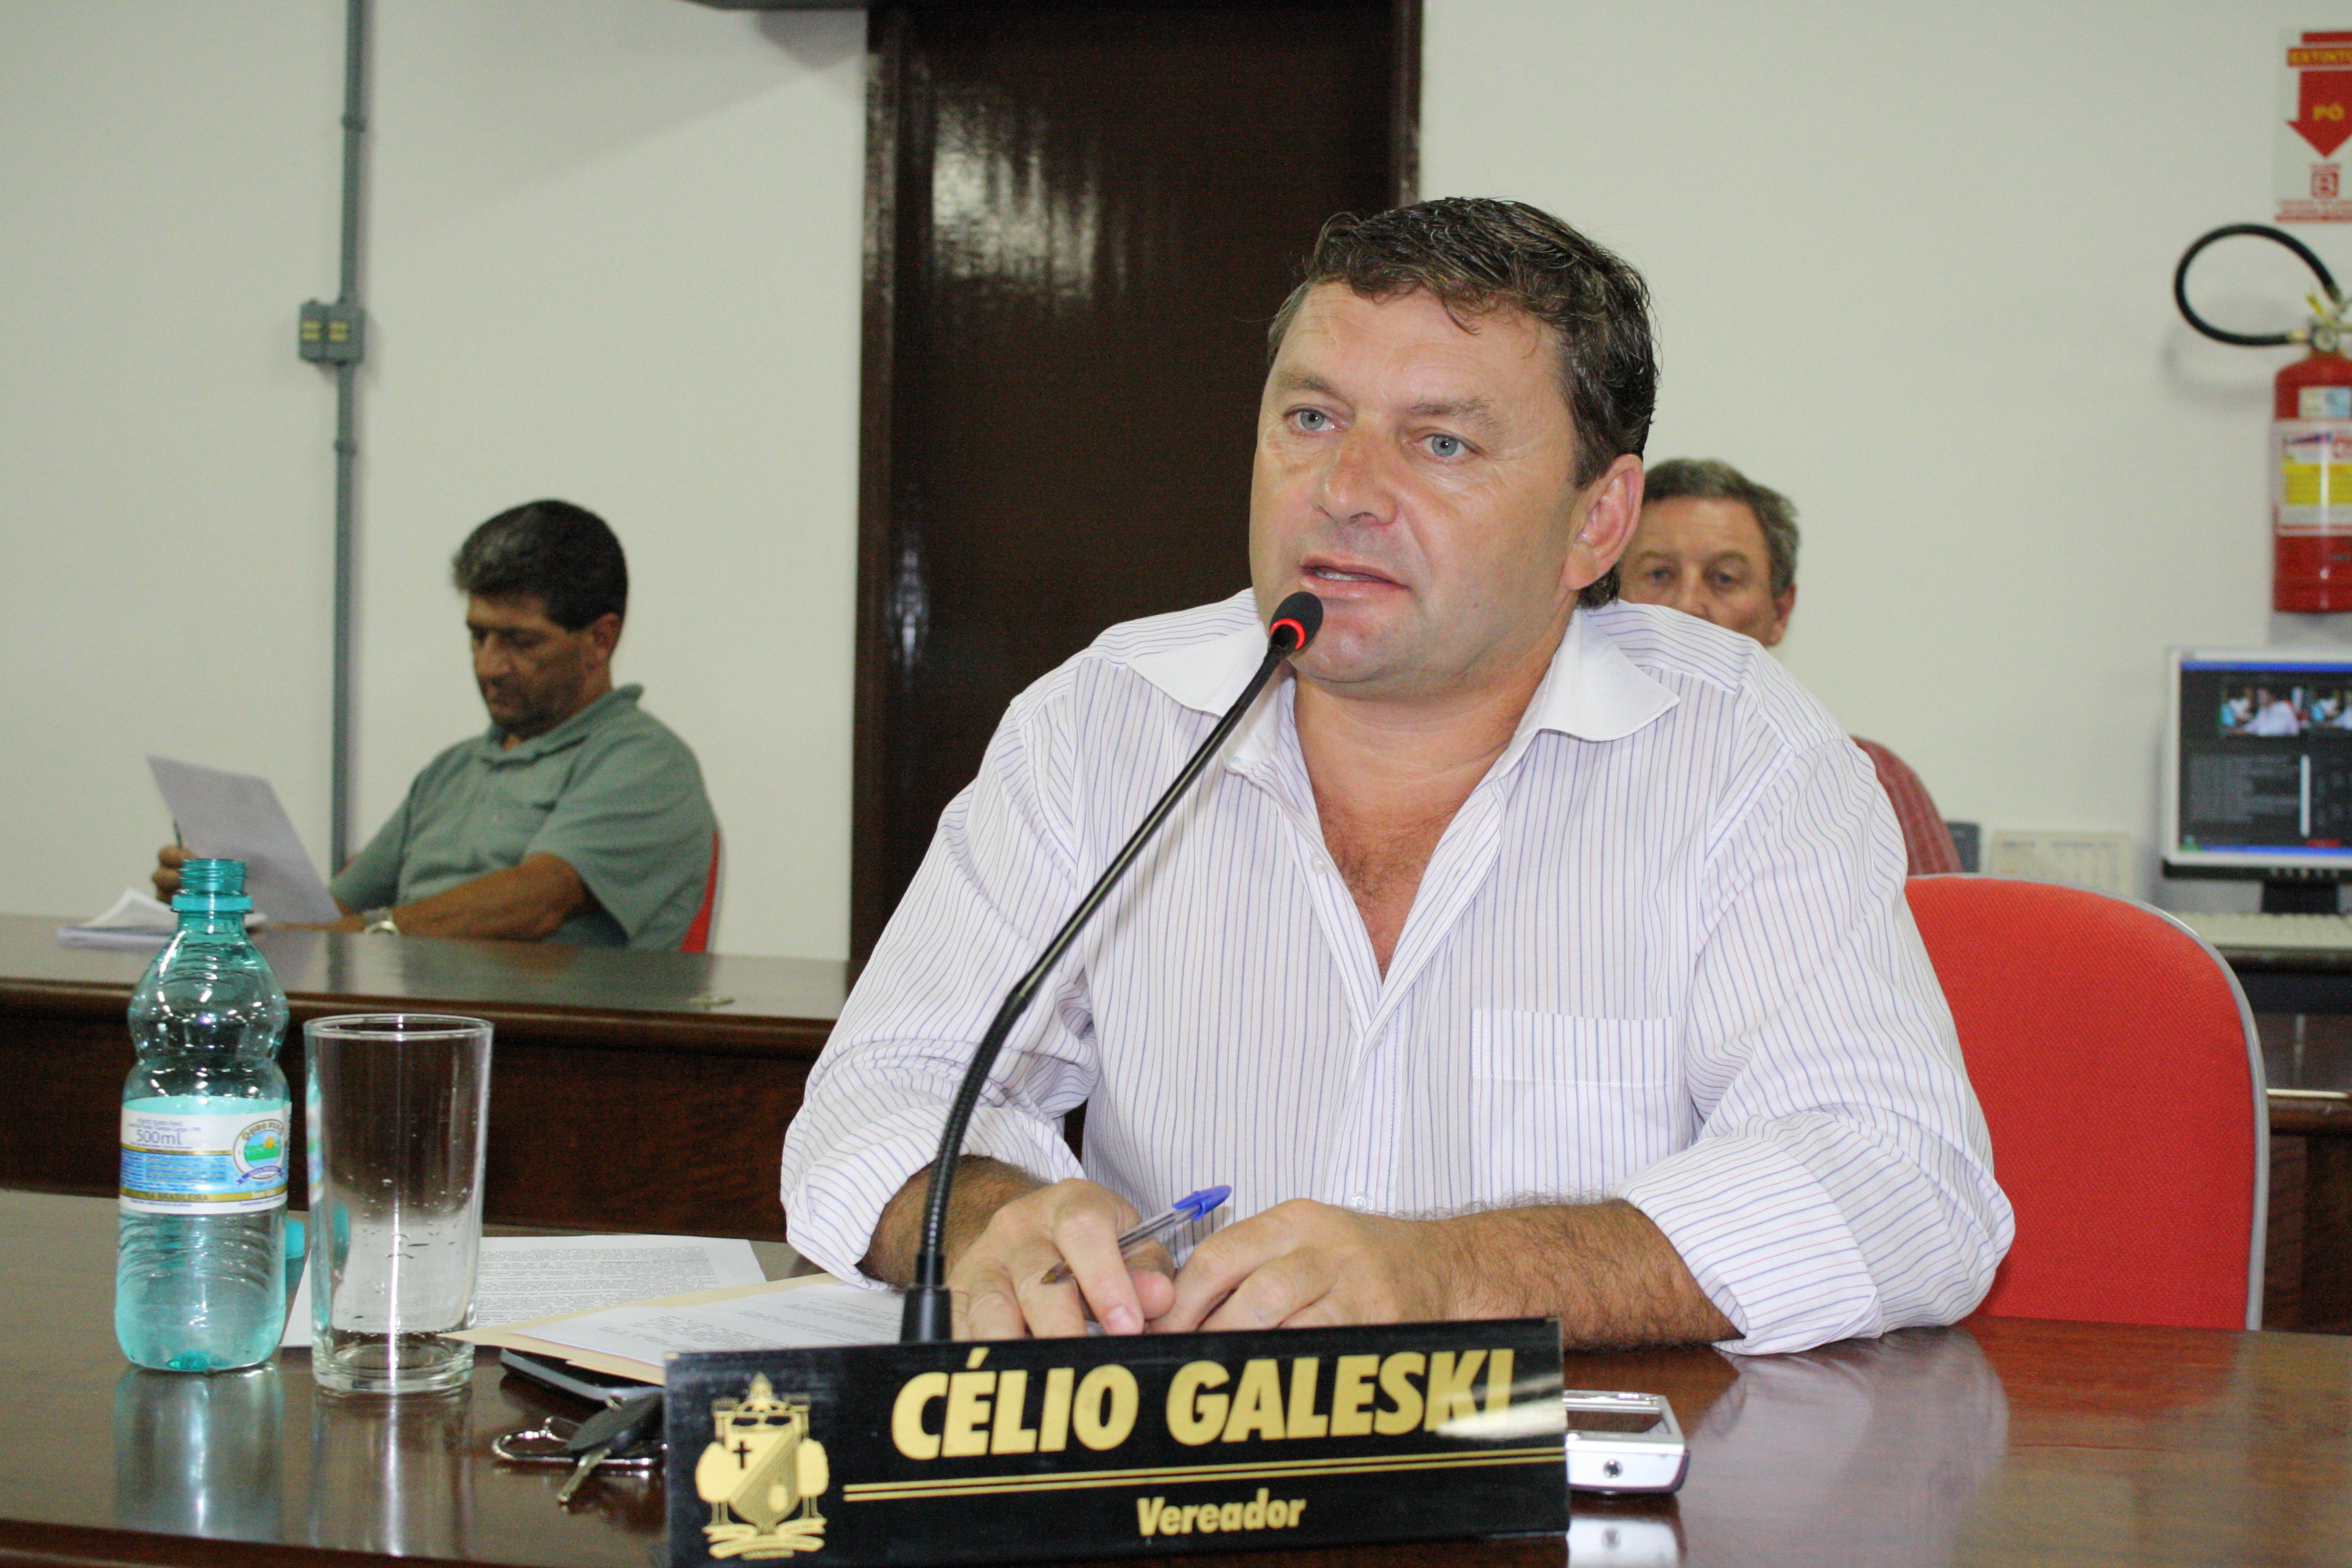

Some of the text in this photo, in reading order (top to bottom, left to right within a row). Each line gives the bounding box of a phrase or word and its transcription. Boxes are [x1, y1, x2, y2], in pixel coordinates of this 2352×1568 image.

[136, 1129, 182, 1145] 500ml
[891, 1347, 1514, 1460] CÉLIO GALESKI
[1137, 1487, 1307, 1537] Vereador
